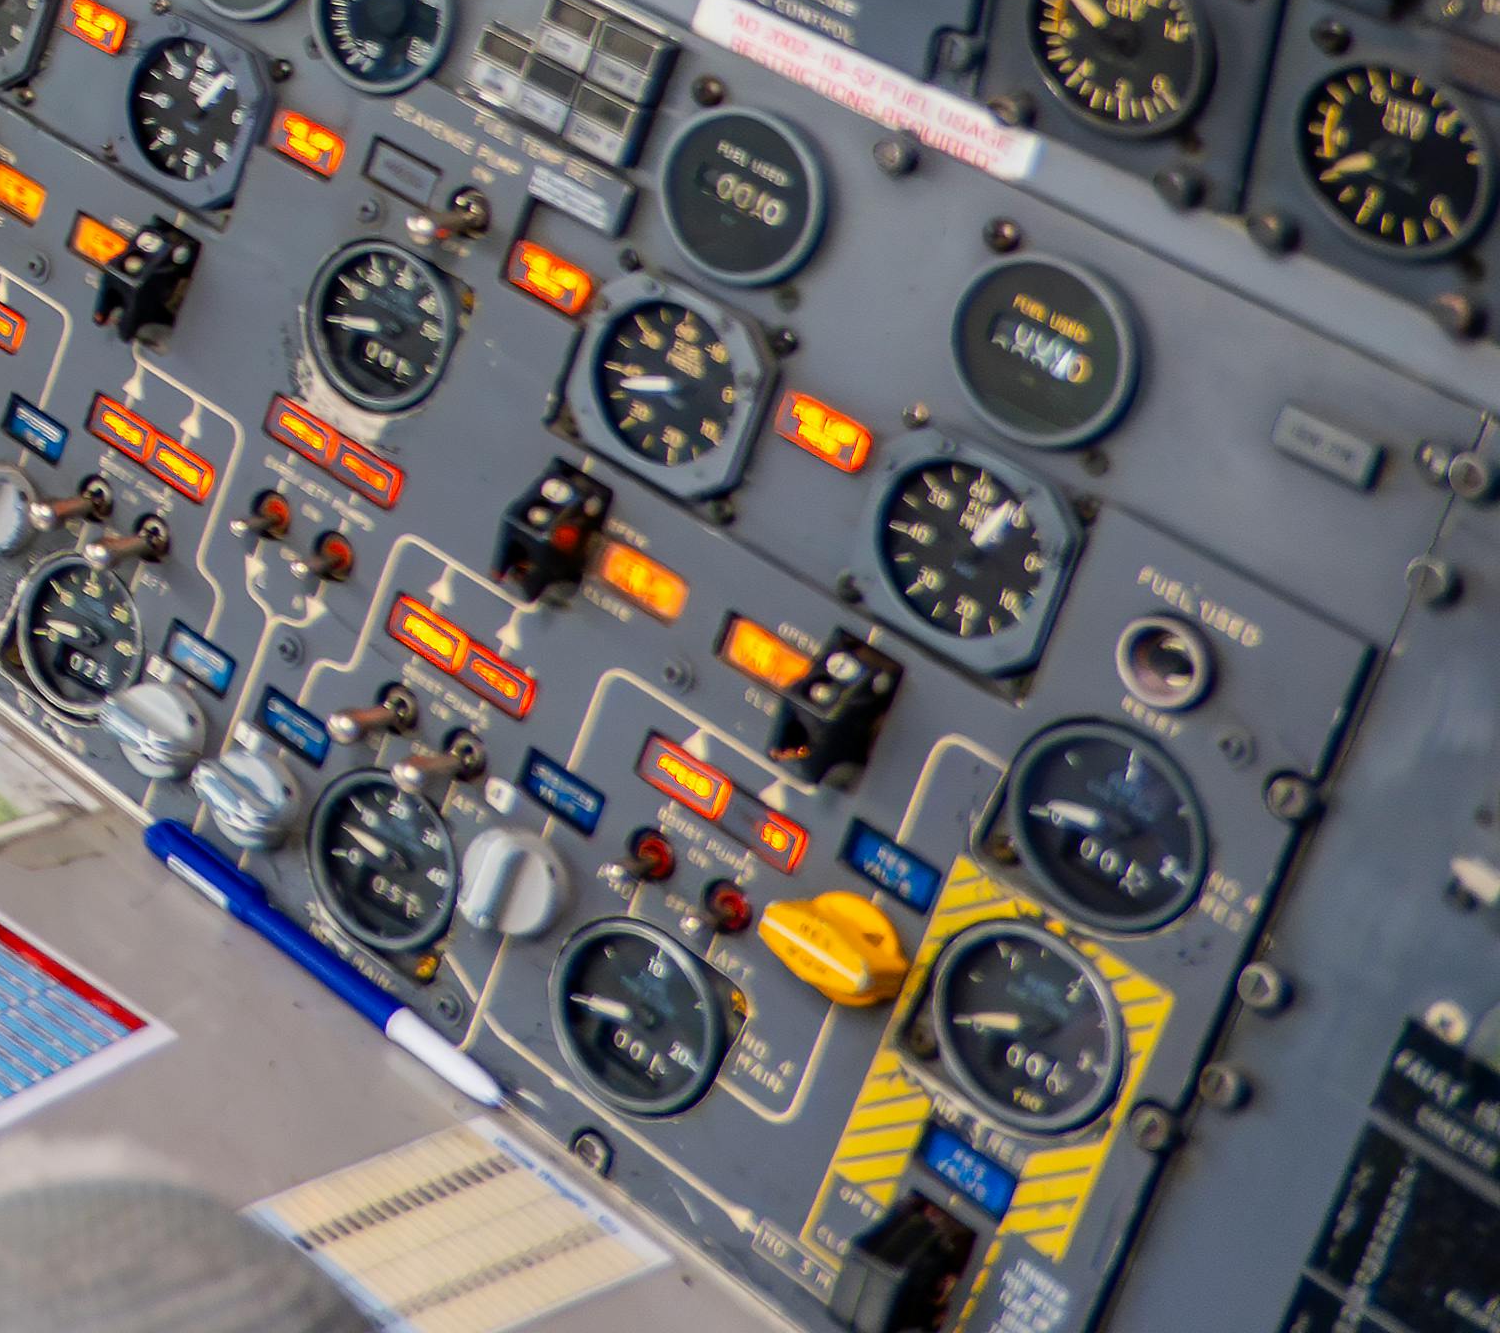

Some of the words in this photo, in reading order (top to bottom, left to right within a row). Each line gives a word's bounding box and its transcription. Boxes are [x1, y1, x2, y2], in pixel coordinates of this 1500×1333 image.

[730, 38, 874, 113] RESTRICTIONS
[880, 79, 930, 112] FUEL
[937, 109, 1015, 149] USAGE
[716, 141, 748, 167] FUEL
[750, 160, 791, 187] USED
[712, 949, 752, 979] AFT
[736, 1053, 785, 1093] MAIN
